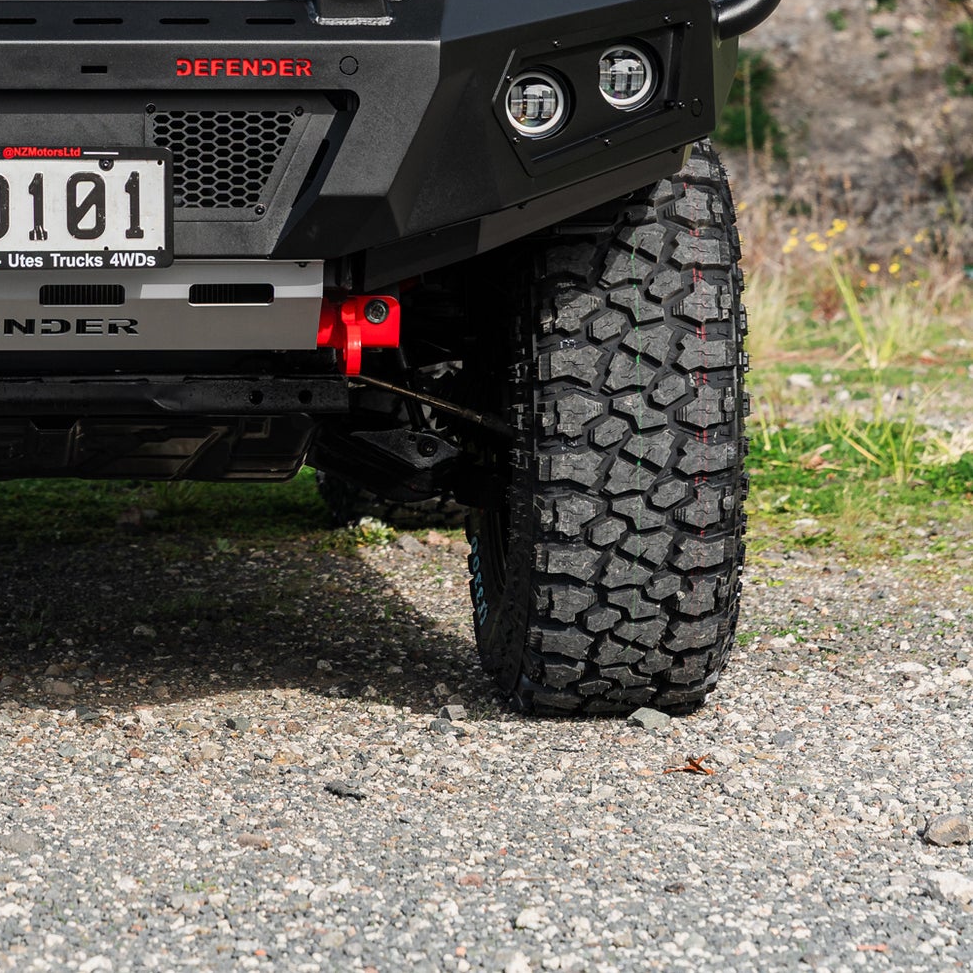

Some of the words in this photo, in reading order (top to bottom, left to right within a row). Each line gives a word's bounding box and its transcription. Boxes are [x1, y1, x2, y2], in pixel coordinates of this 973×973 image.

[176, 58, 313, 77] DEFENDER
[2, 147, 81, 159] @NZMotorsLtd
[8, 253, 44, 268] Utes
[50, 253, 103, 268] Trucks
[109, 253, 157, 267] 4WDs
